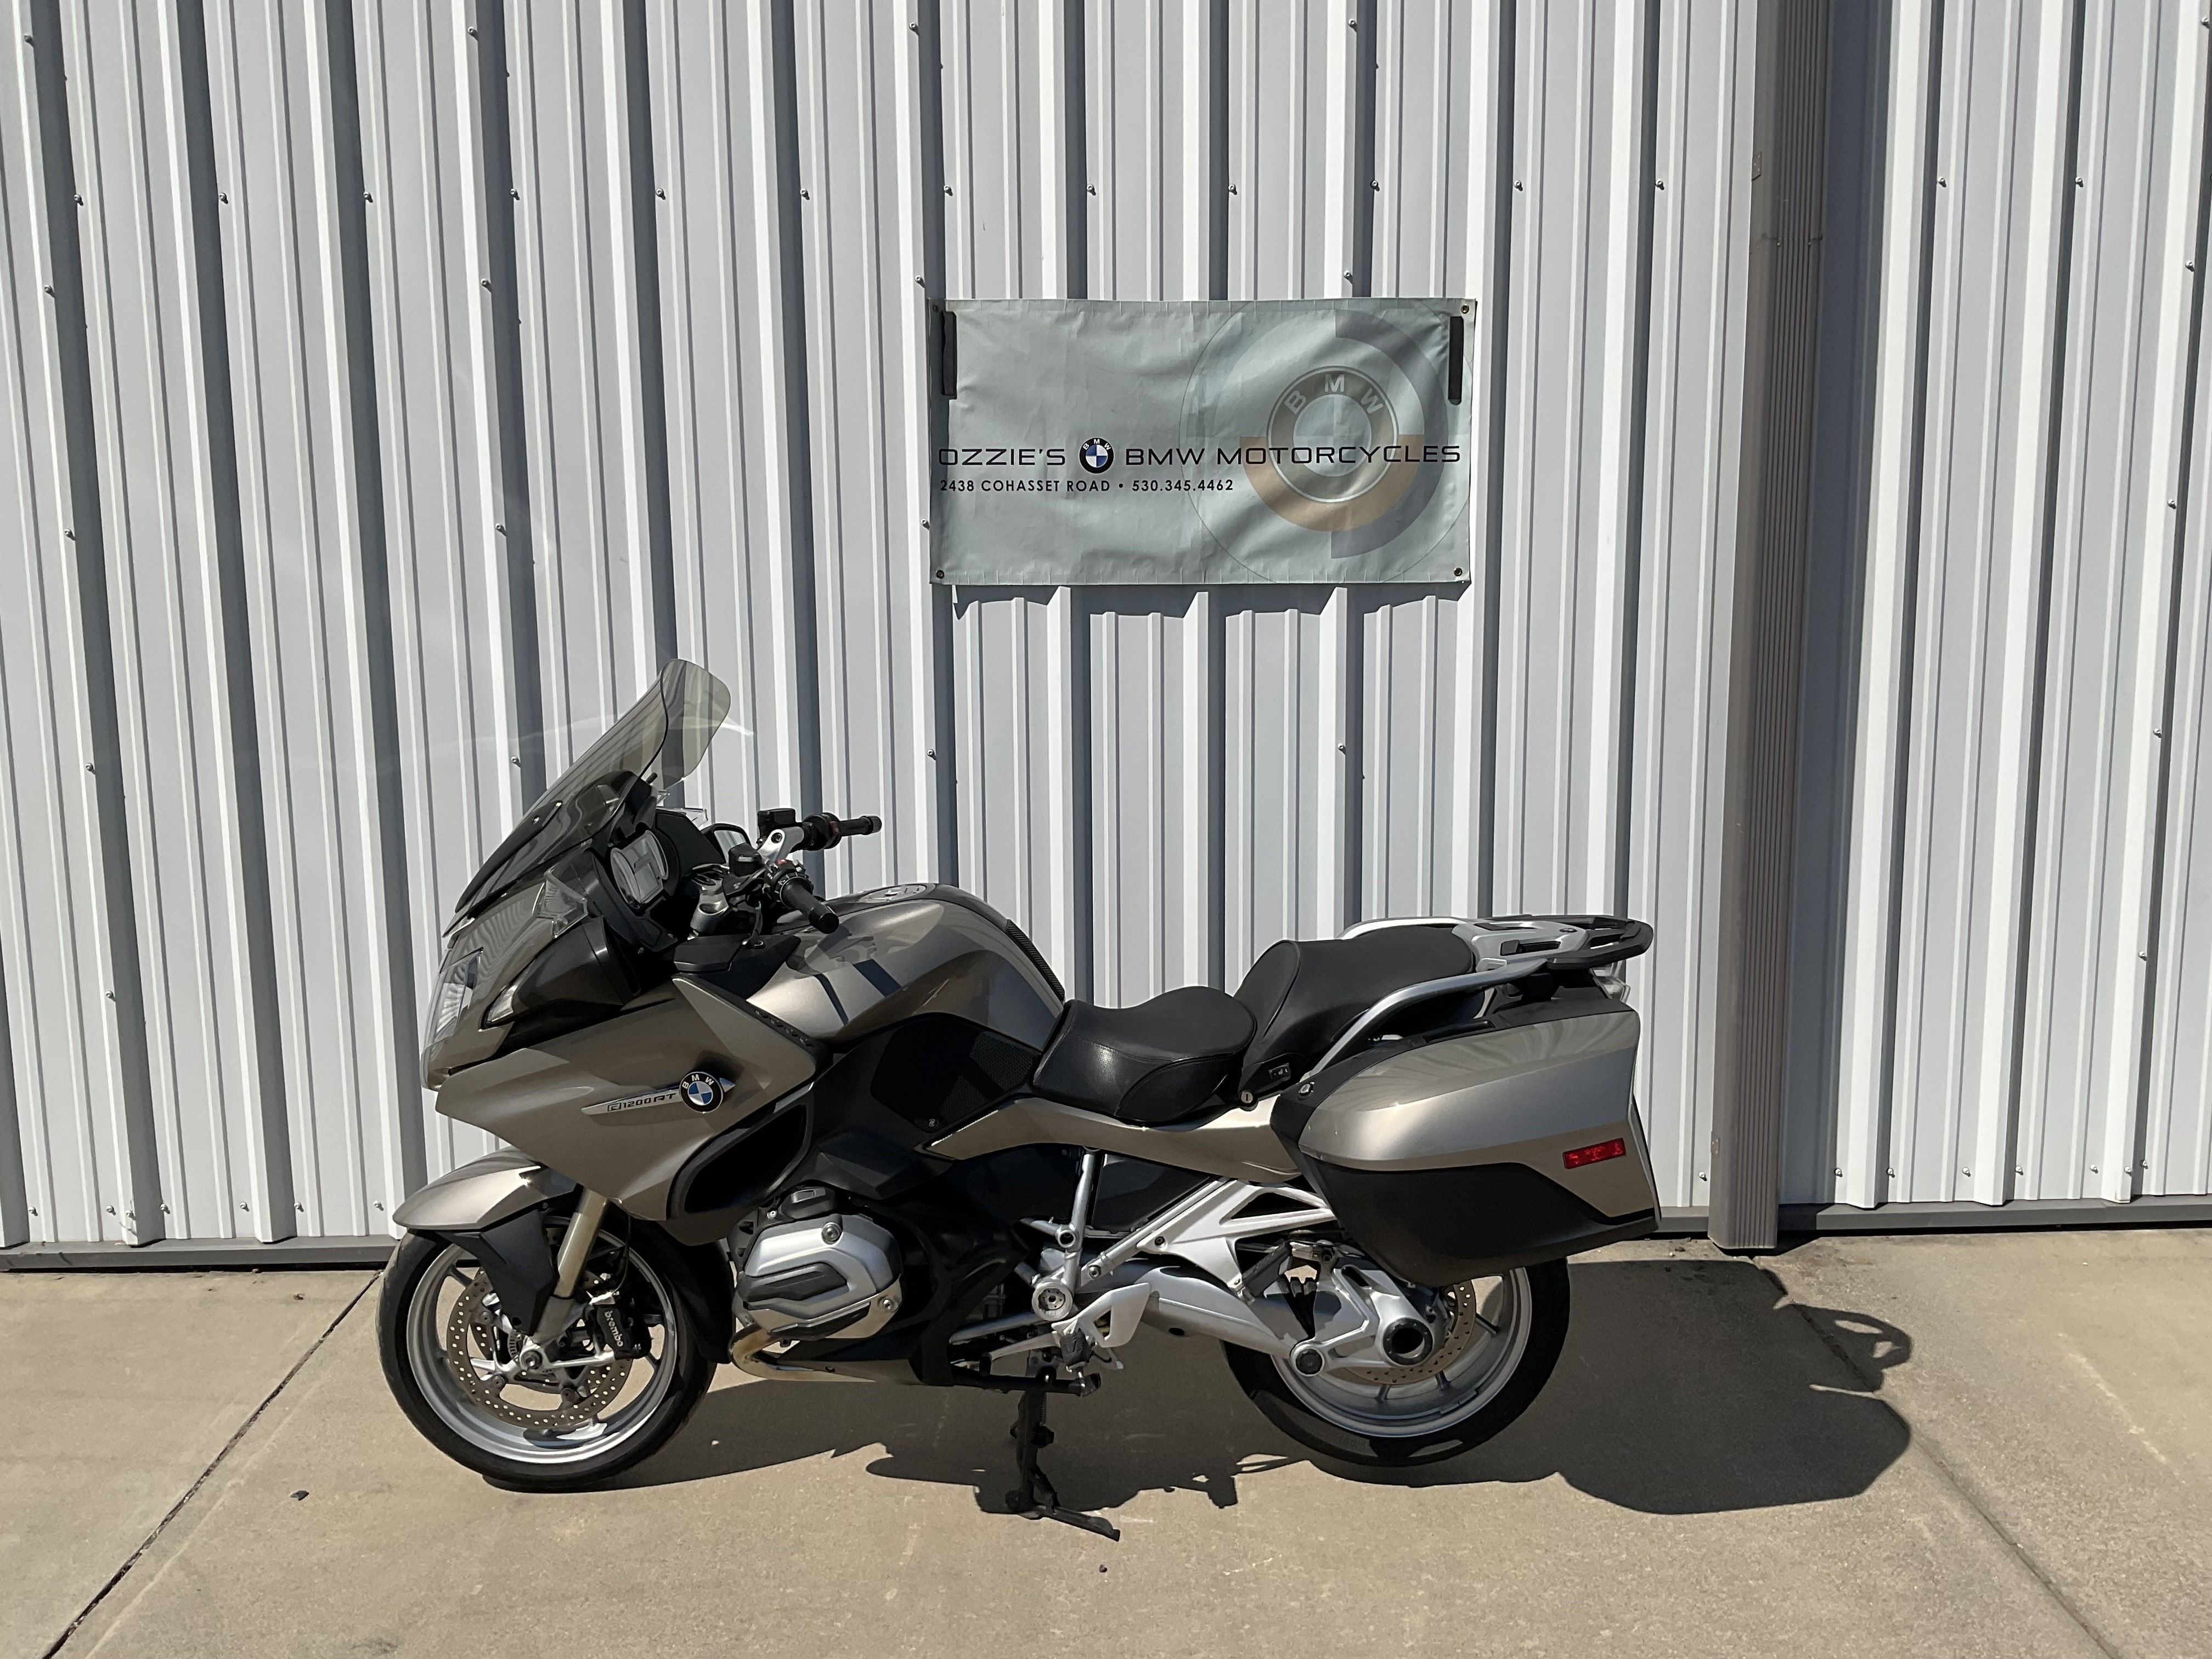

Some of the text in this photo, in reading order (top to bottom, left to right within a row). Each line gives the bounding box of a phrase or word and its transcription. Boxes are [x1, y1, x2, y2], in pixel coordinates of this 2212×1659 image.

[1284, 374, 1384, 415] BMW
[1082, 438, 1111, 450] BMW
[938, 445, 1460, 466] OZZIE'S BMW MOTORCYCLES
[940, 479, 1233, 492] 2438 COHASSET ROAD 530.345.4462
[682, 1074, 714, 1089] BMW
[604, 1310, 624, 1347] brembo
